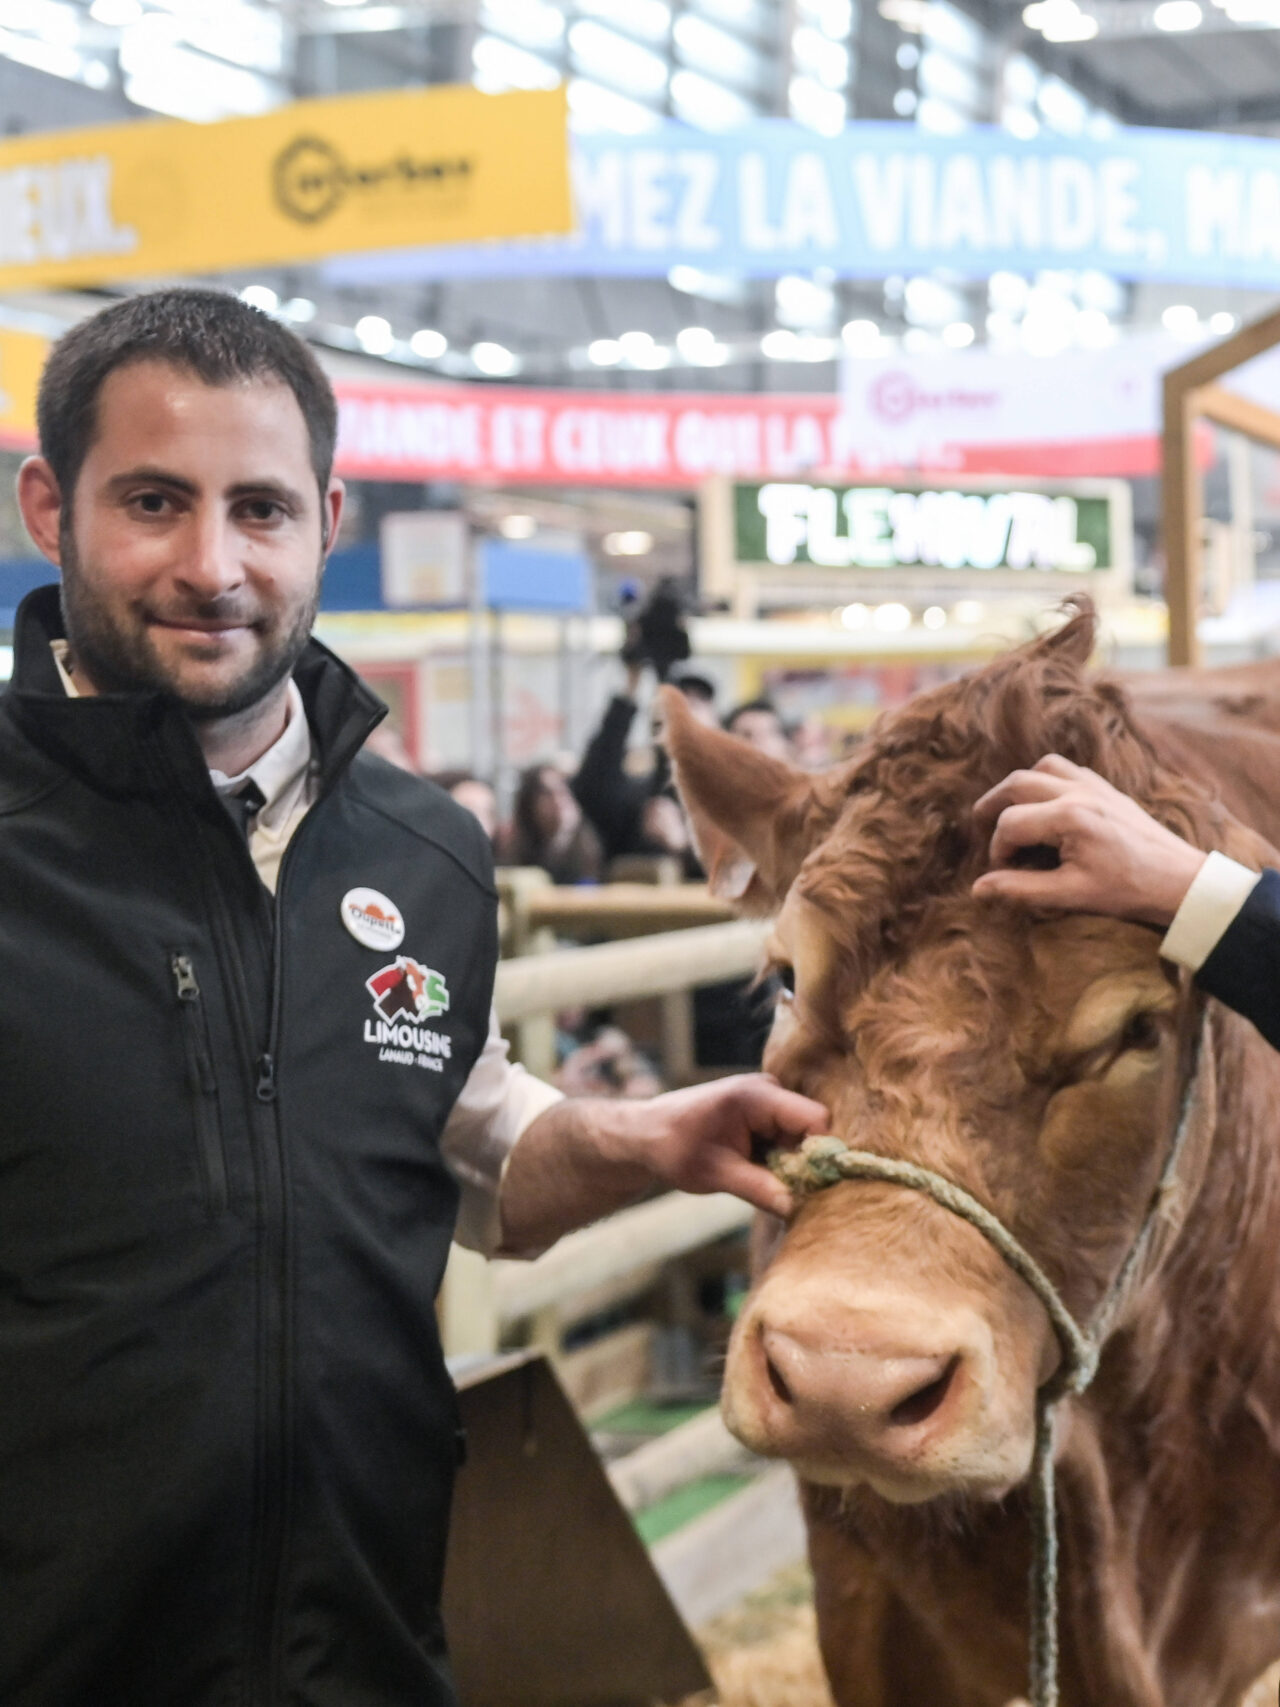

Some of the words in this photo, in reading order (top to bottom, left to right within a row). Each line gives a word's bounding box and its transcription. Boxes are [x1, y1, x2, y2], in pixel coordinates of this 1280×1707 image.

[736, 150, 839, 253] LA
[851, 150, 1167, 267] VIANDE,
[363, 1018, 452, 1059] LIMOUSINE
